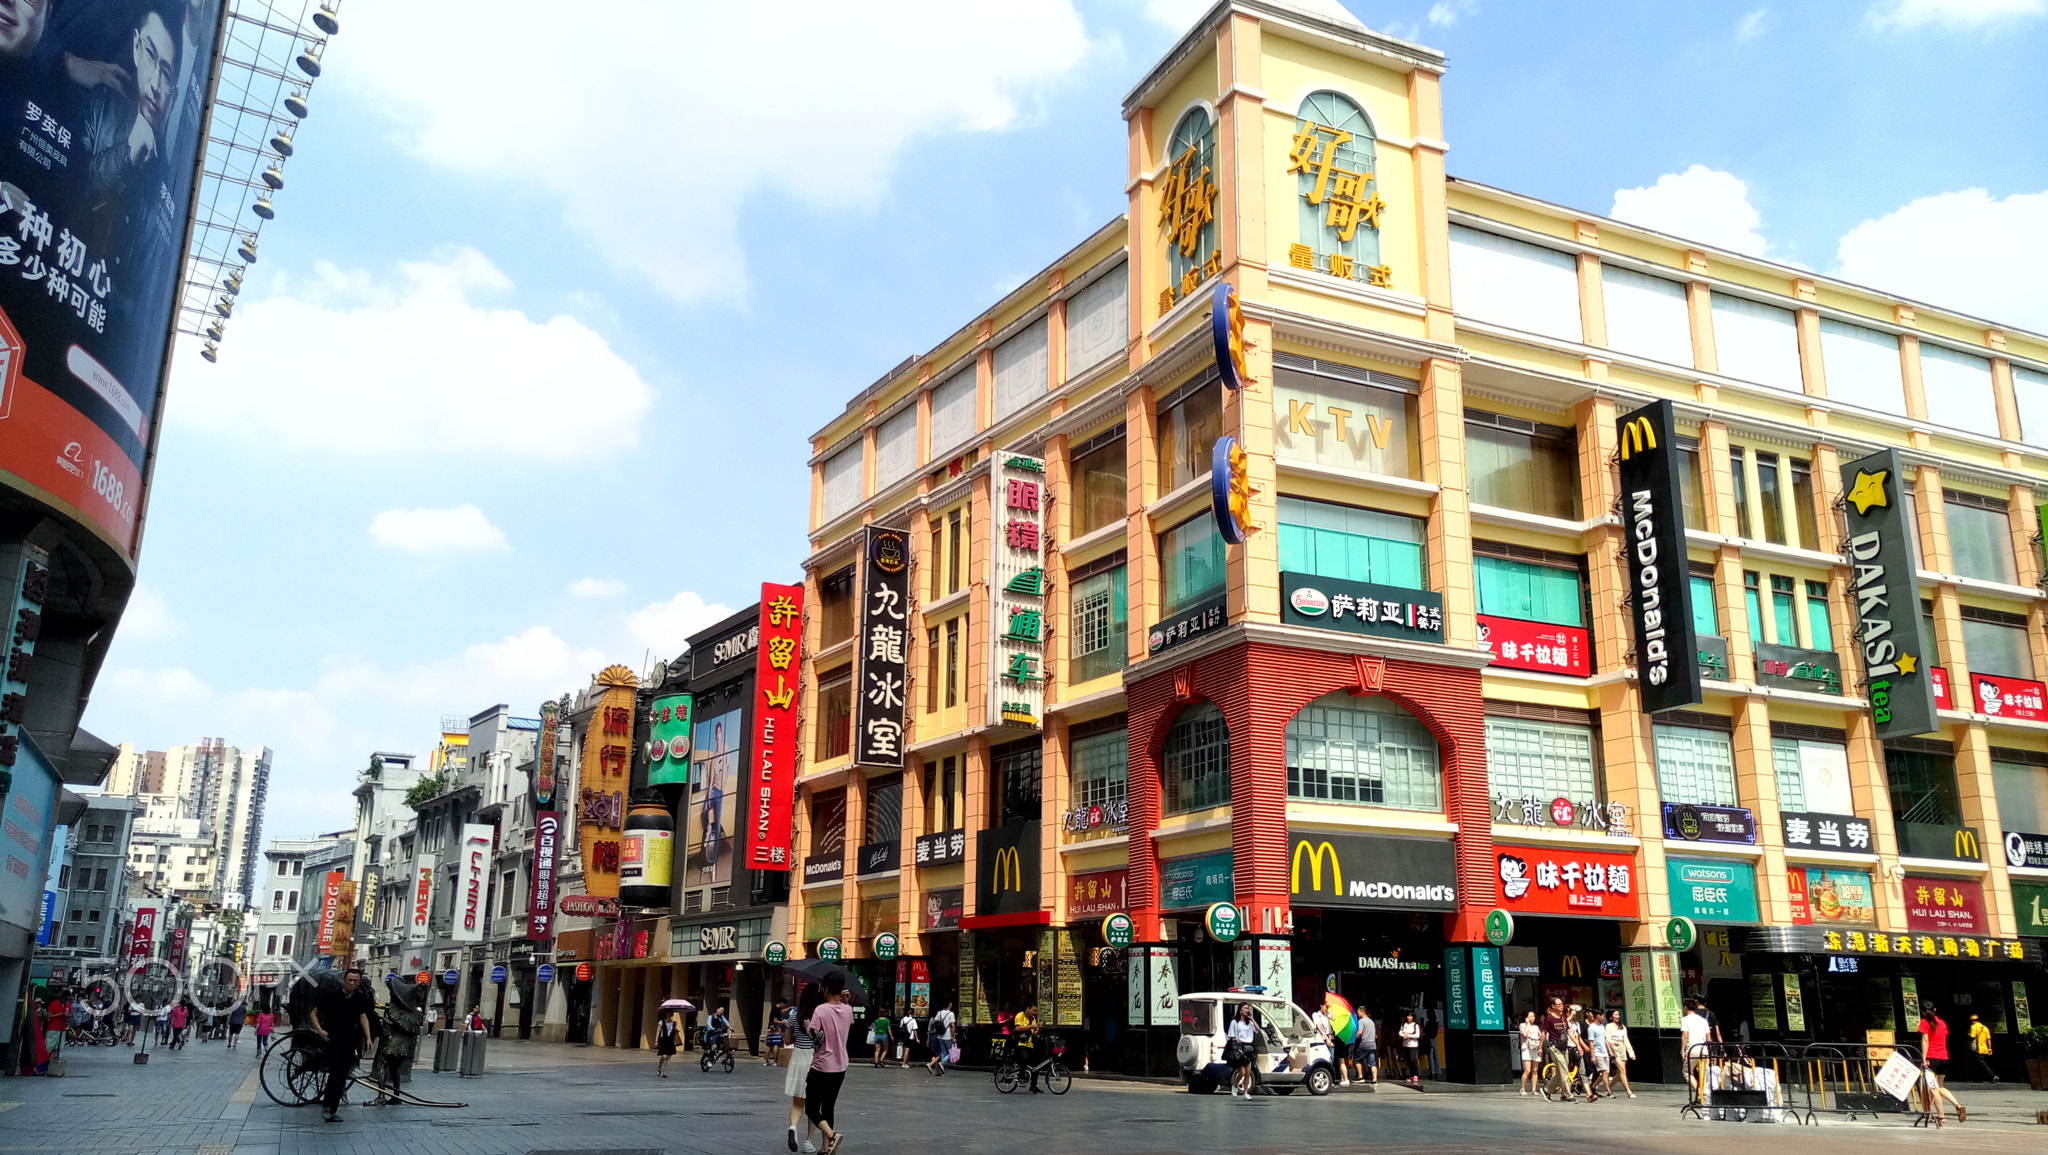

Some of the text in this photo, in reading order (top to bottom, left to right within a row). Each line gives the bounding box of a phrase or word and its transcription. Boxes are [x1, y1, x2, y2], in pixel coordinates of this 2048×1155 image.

[25, 101, 71, 149] 罗英保
[19, 139, 51, 170] 有限公司
[1288, 242, 1394, 289] 量贩式
[1288, 399, 1393, 450] KTV
[1631, 489, 1669, 687] McDonald's
[1331, 593, 1405, 625] 萨莉亚
[1165, 615, 1201, 645] 萨莉亚
[1851, 530, 1899, 724] DAKASI tea
[763, 596, 800, 710] 許留山
[867, 582, 905, 758] 九龍冰室
[764, 717, 775, 744] HUI
[761, 750, 773, 781] LAU
[1581, 800, 1628, 833] 冰室
[917, 833, 965, 863] 麦当劳
[1786, 817, 1869, 849] 麦当劳
[754, 845, 786, 865] 三楼
[805, 860, 842, 876] McDonald's
[1687, 868, 1727, 879] watsons
[464, 851, 483, 930] LI-NING
[1350, 880, 1455, 902] McDonald's
[1692, 887, 1728, 903] 屈臣氏
[322, 898, 337, 943] GIONEE
[1069, 905, 1080, 914] HUI
[1082, 904, 1096, 913] LAU
[1912, 908, 1927, 917] HUI
[1929, 909, 1946, 918] LAU
[131, 914, 152, 969] 周六福
[1358, 956, 1398, 970] DAKASI
[1417, 962, 1430, 970] tea
[1481, 968, 1495, 1015] 屈臣氏
